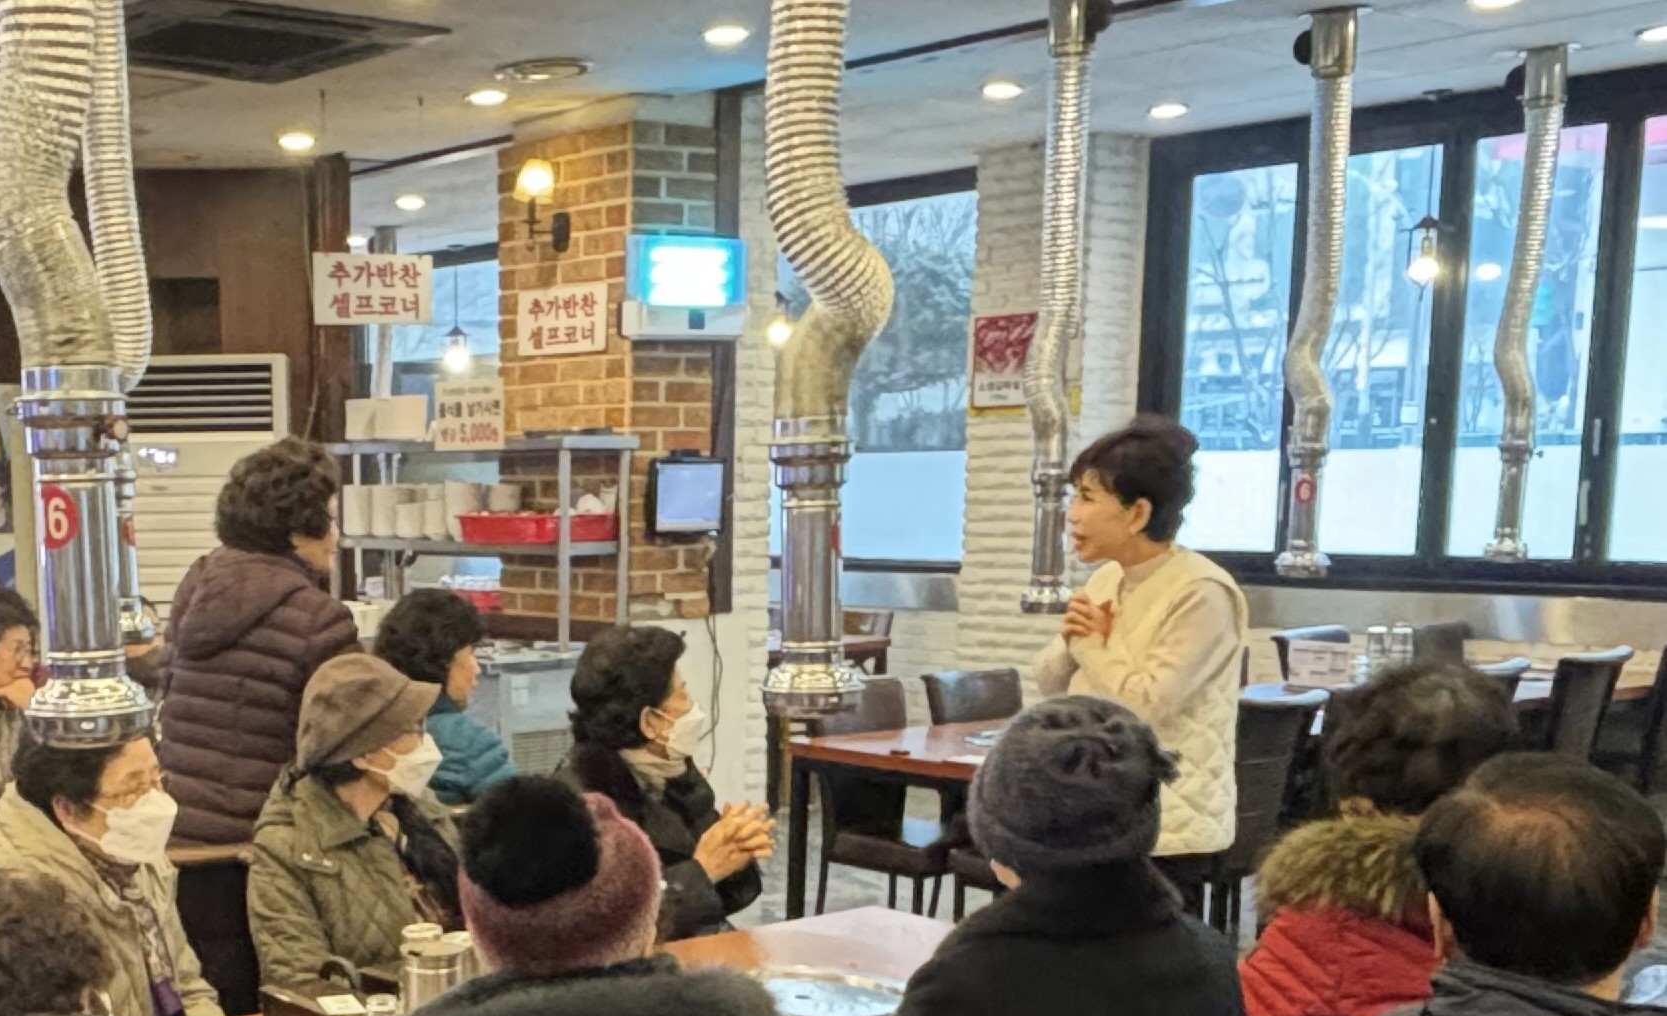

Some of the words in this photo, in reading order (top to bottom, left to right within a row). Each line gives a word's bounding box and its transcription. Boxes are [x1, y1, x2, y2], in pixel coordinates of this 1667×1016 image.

[328, 260, 421, 287] 추가반찬
[329, 292, 420, 319] 셀프코너
[528, 292, 597, 321] 추가반찬
[528, 321, 596, 349] 셀프코너
[47, 496, 70, 540] 6
